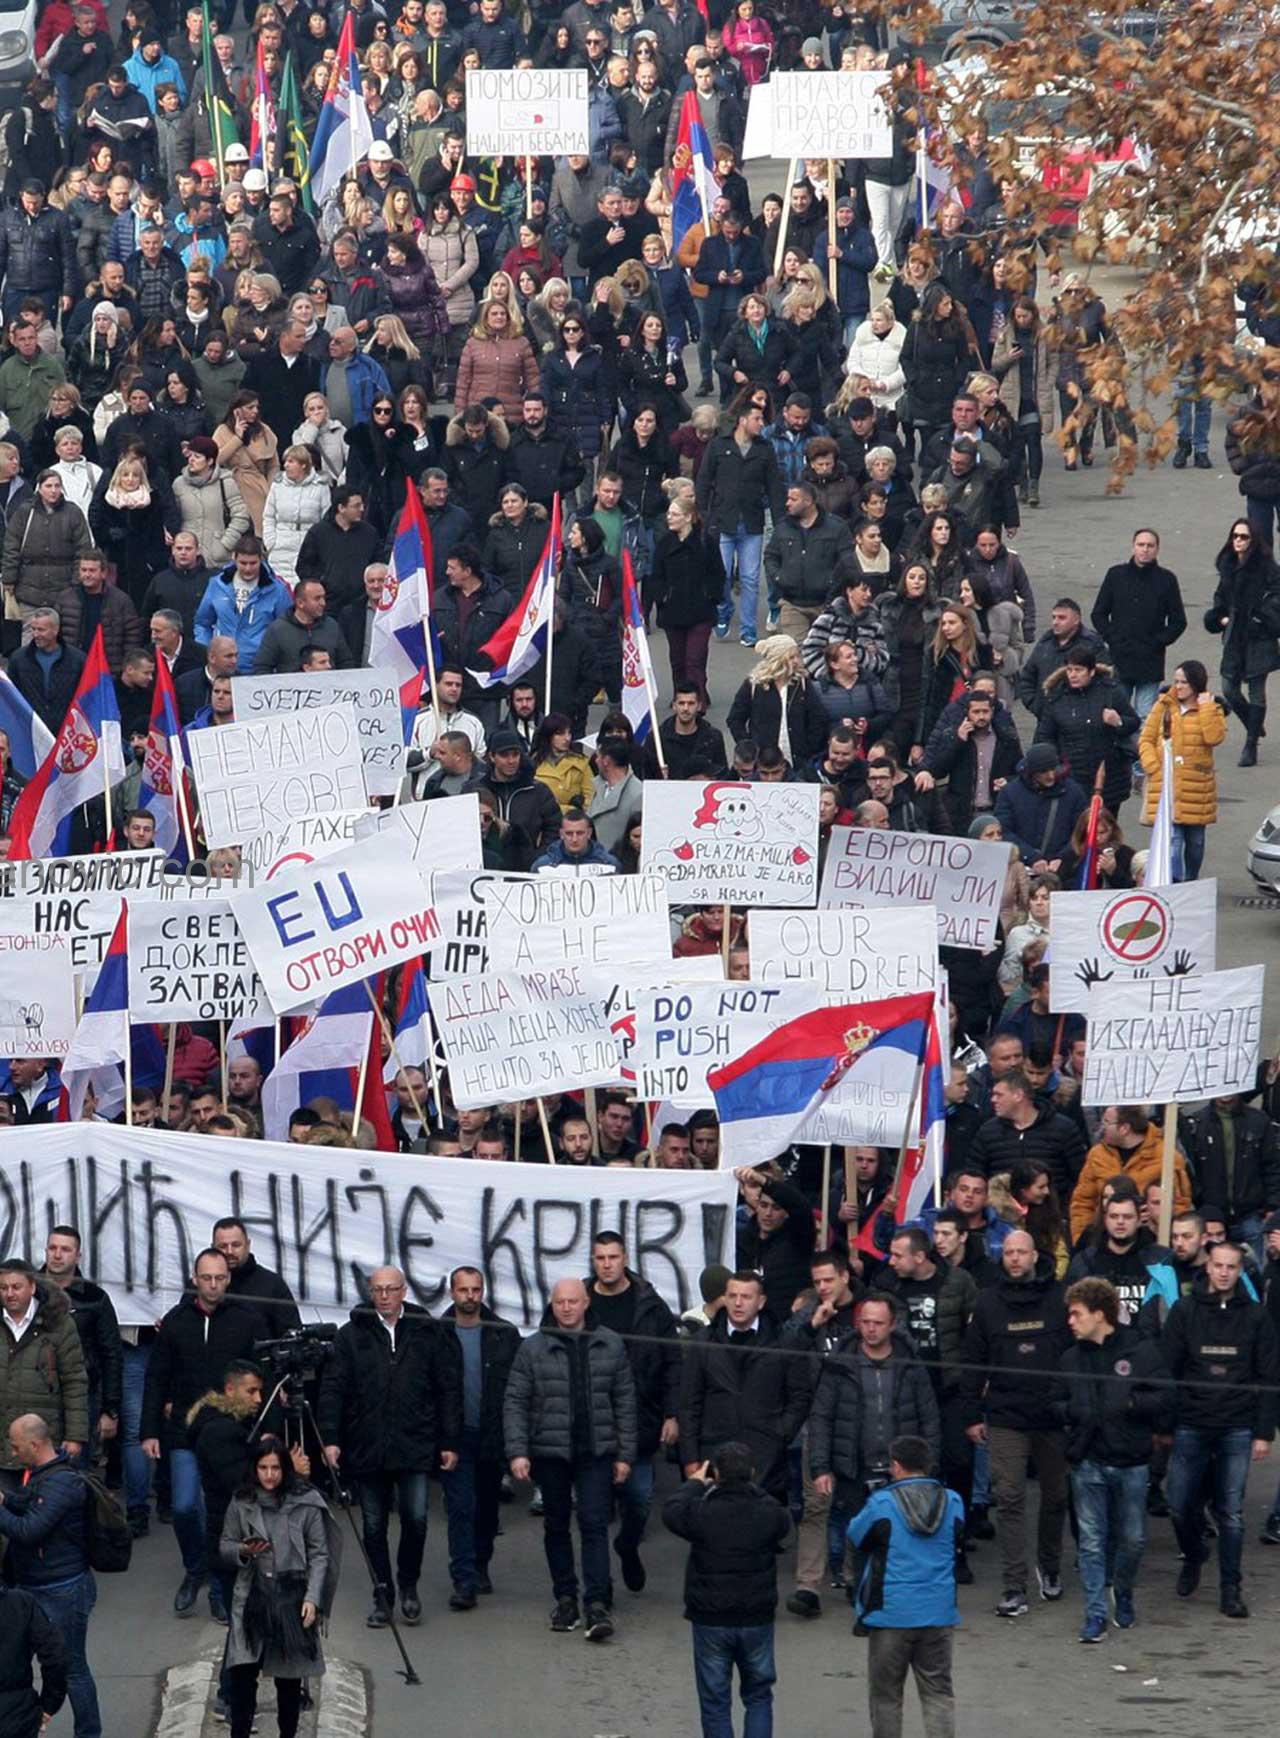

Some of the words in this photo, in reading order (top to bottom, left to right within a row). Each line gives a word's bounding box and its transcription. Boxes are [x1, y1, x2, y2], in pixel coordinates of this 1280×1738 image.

[469, 71, 587, 100] ПОМОЗИТЕ
[775, 74, 878, 103] ИМАМО
[776, 103, 858, 131] ПРАВО
[469, 132, 524, 153] НАШИМ
[528, 131, 588, 152] БЕБАМА
[194, 711, 350, 782] НЕМАМО
[845, 829, 973, 870] ЕВРОПО
[487, 878, 596, 929] ХОЋЕМО
[609, 875, 666, 917] МИР
[834, 860, 938, 901] ВИДИШ
[951, 875, 997, 907] ЛИ
[34, 898, 91, 933] НАС
[780, 915, 877, 957] OUR
[140, 941, 247, 973] ДОКЛЕ
[286, 929, 387, 992] ОТВОРИ
[390, 906, 442, 949] ОЧИ!
[515, 931, 534, 968] А
[562, 924, 610, 963] НЕ
[762, 953, 937, 992] CHILDREN
[199, 999, 259, 1020] ОЧИ?
[446, 978, 517, 1023] ДЕДА
[521, 966, 587, 1003] МРАЗЕ
[654, 994, 693, 1023] DO
[718, 989, 781, 1017] NOT
[1149, 975, 1202, 1012] НЕ
[443, 1021, 501, 1059] НАША
[509, 1009, 561, 1048] ДЕЦА
[656, 1024, 730, 1060] PUSH
[1090, 1005, 1259, 1051] ИЗГЛАДЊУЈТЕ
[462, 1054, 533, 1097] НЕШТО
[538, 1050, 565, 1081] ЗА
[1084, 1053, 1169, 1099] НАШУ
[1172, 1045, 1259, 1097] ДЕЦУ
[229, 1167, 448, 1306] НИЈЕ
